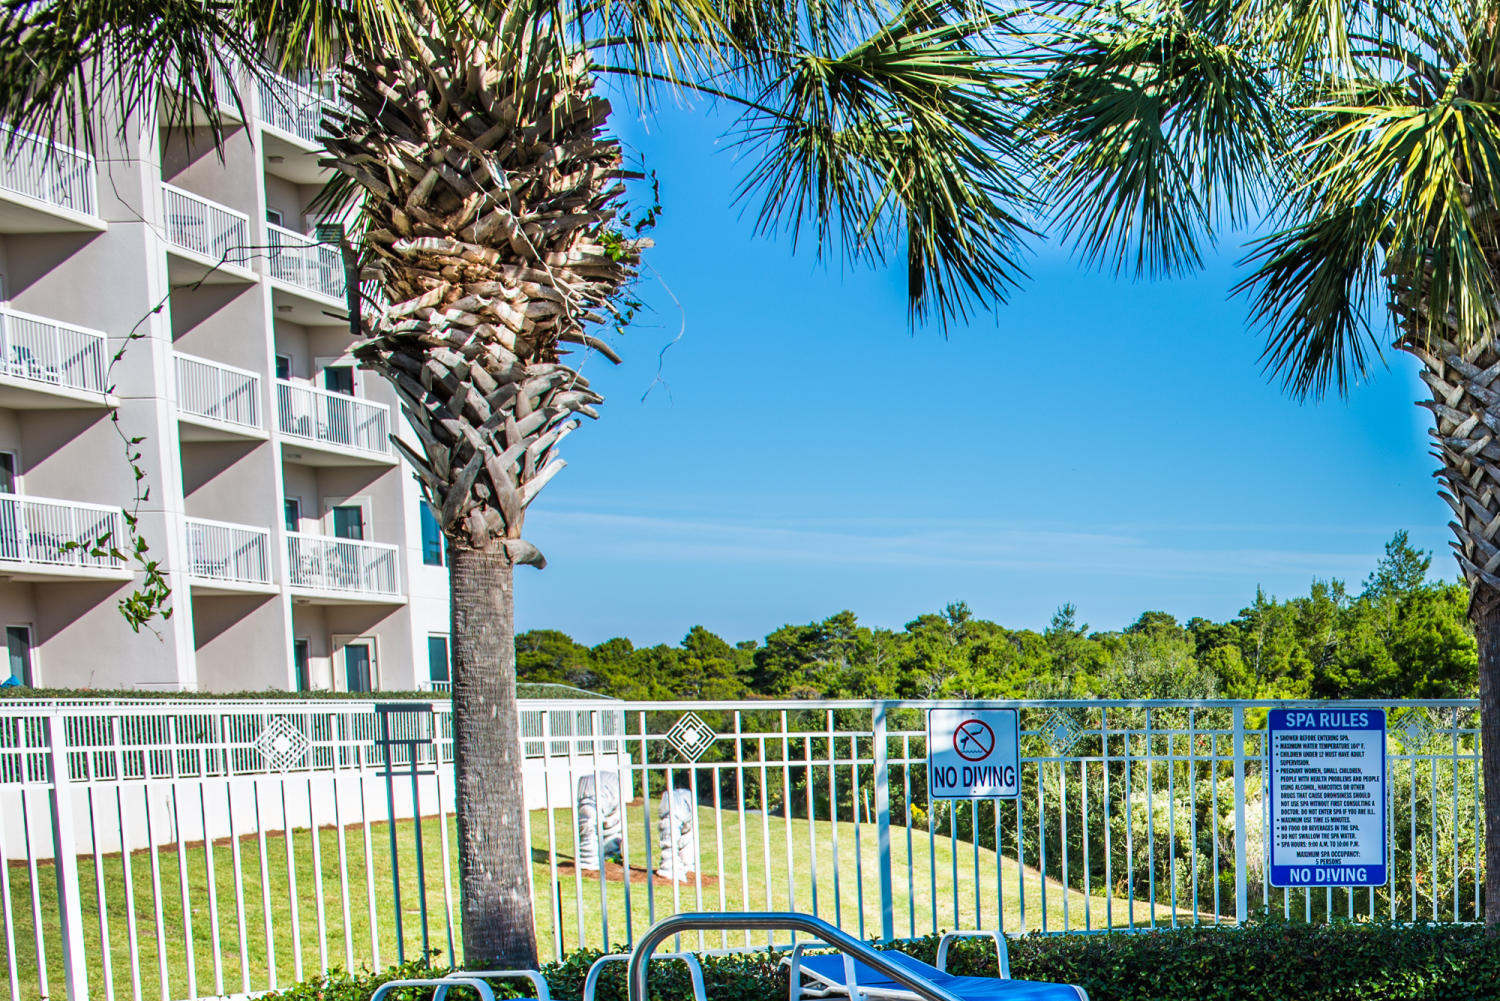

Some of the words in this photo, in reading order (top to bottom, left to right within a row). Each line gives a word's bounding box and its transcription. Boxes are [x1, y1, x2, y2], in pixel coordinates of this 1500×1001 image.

[1286, 713, 1316, 727] SPA
[1320, 713, 1368, 727] RULES
[934, 766, 957, 788] NO
[963, 766, 1014, 787] DIVING
[1290, 868, 1311, 882] NO
[1316, 868, 1367, 882] DIVING
